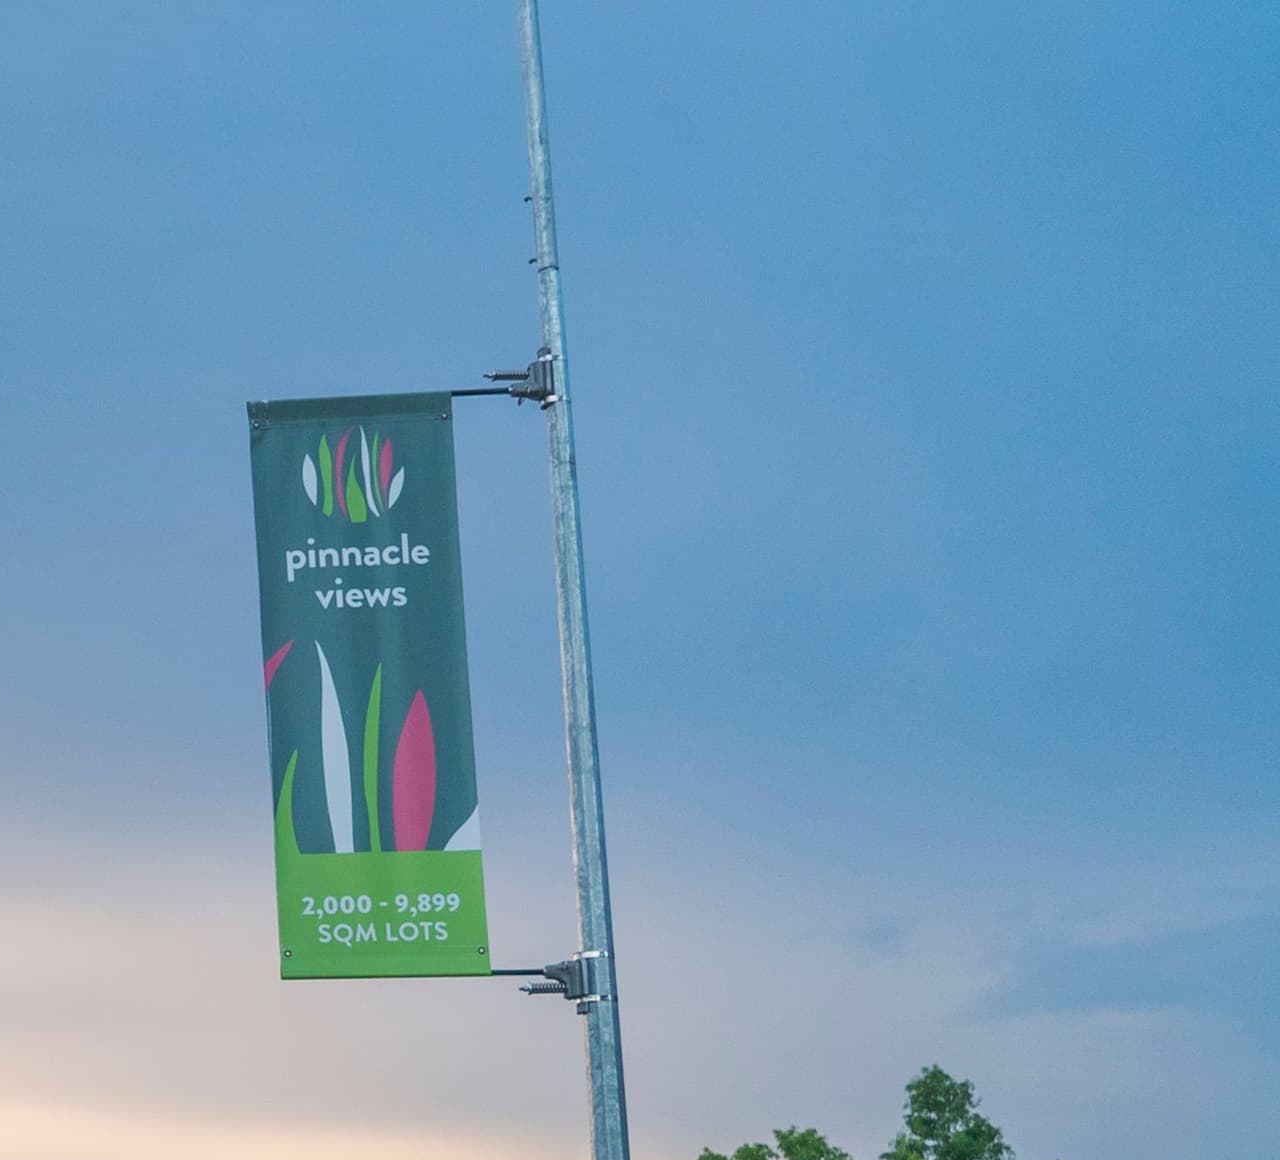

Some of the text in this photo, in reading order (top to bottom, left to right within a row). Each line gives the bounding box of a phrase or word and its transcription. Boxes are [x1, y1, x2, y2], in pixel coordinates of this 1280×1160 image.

[286, 533, 430, 582] pinnacle
[315, 577, 408, 609] views
[301, 895, 372, 920] 2,000
[394, 893, 461, 918] 9,899
[318, 921, 449, 947] SQM LOTS
